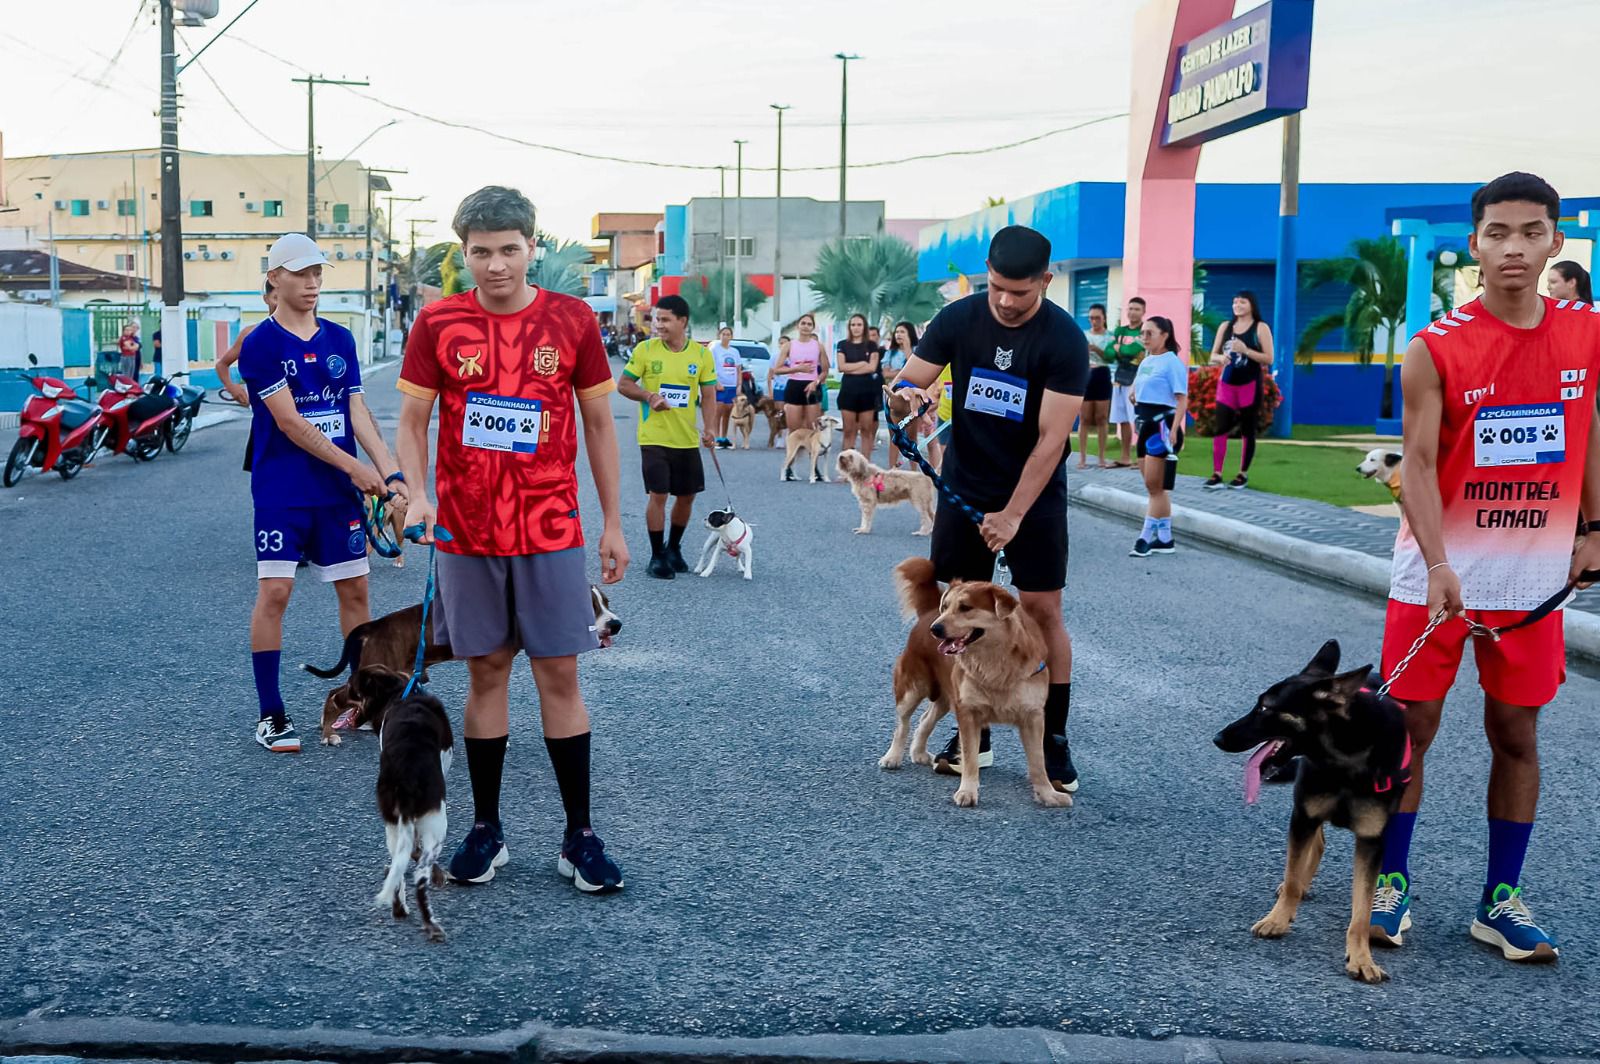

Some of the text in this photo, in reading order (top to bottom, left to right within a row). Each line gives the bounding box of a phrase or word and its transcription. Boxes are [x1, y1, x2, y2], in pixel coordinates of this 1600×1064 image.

[1180, 44, 1211, 75] CENTRO
[1222, 25, 1251, 57] LAZER
[1202, 61, 1254, 111] PANDOLFO
[984, 386, 1011, 403] 008
[484, 415, 517, 433] 006
[1499, 426, 1538, 444] 003
[257, 530, 284, 552] 33
